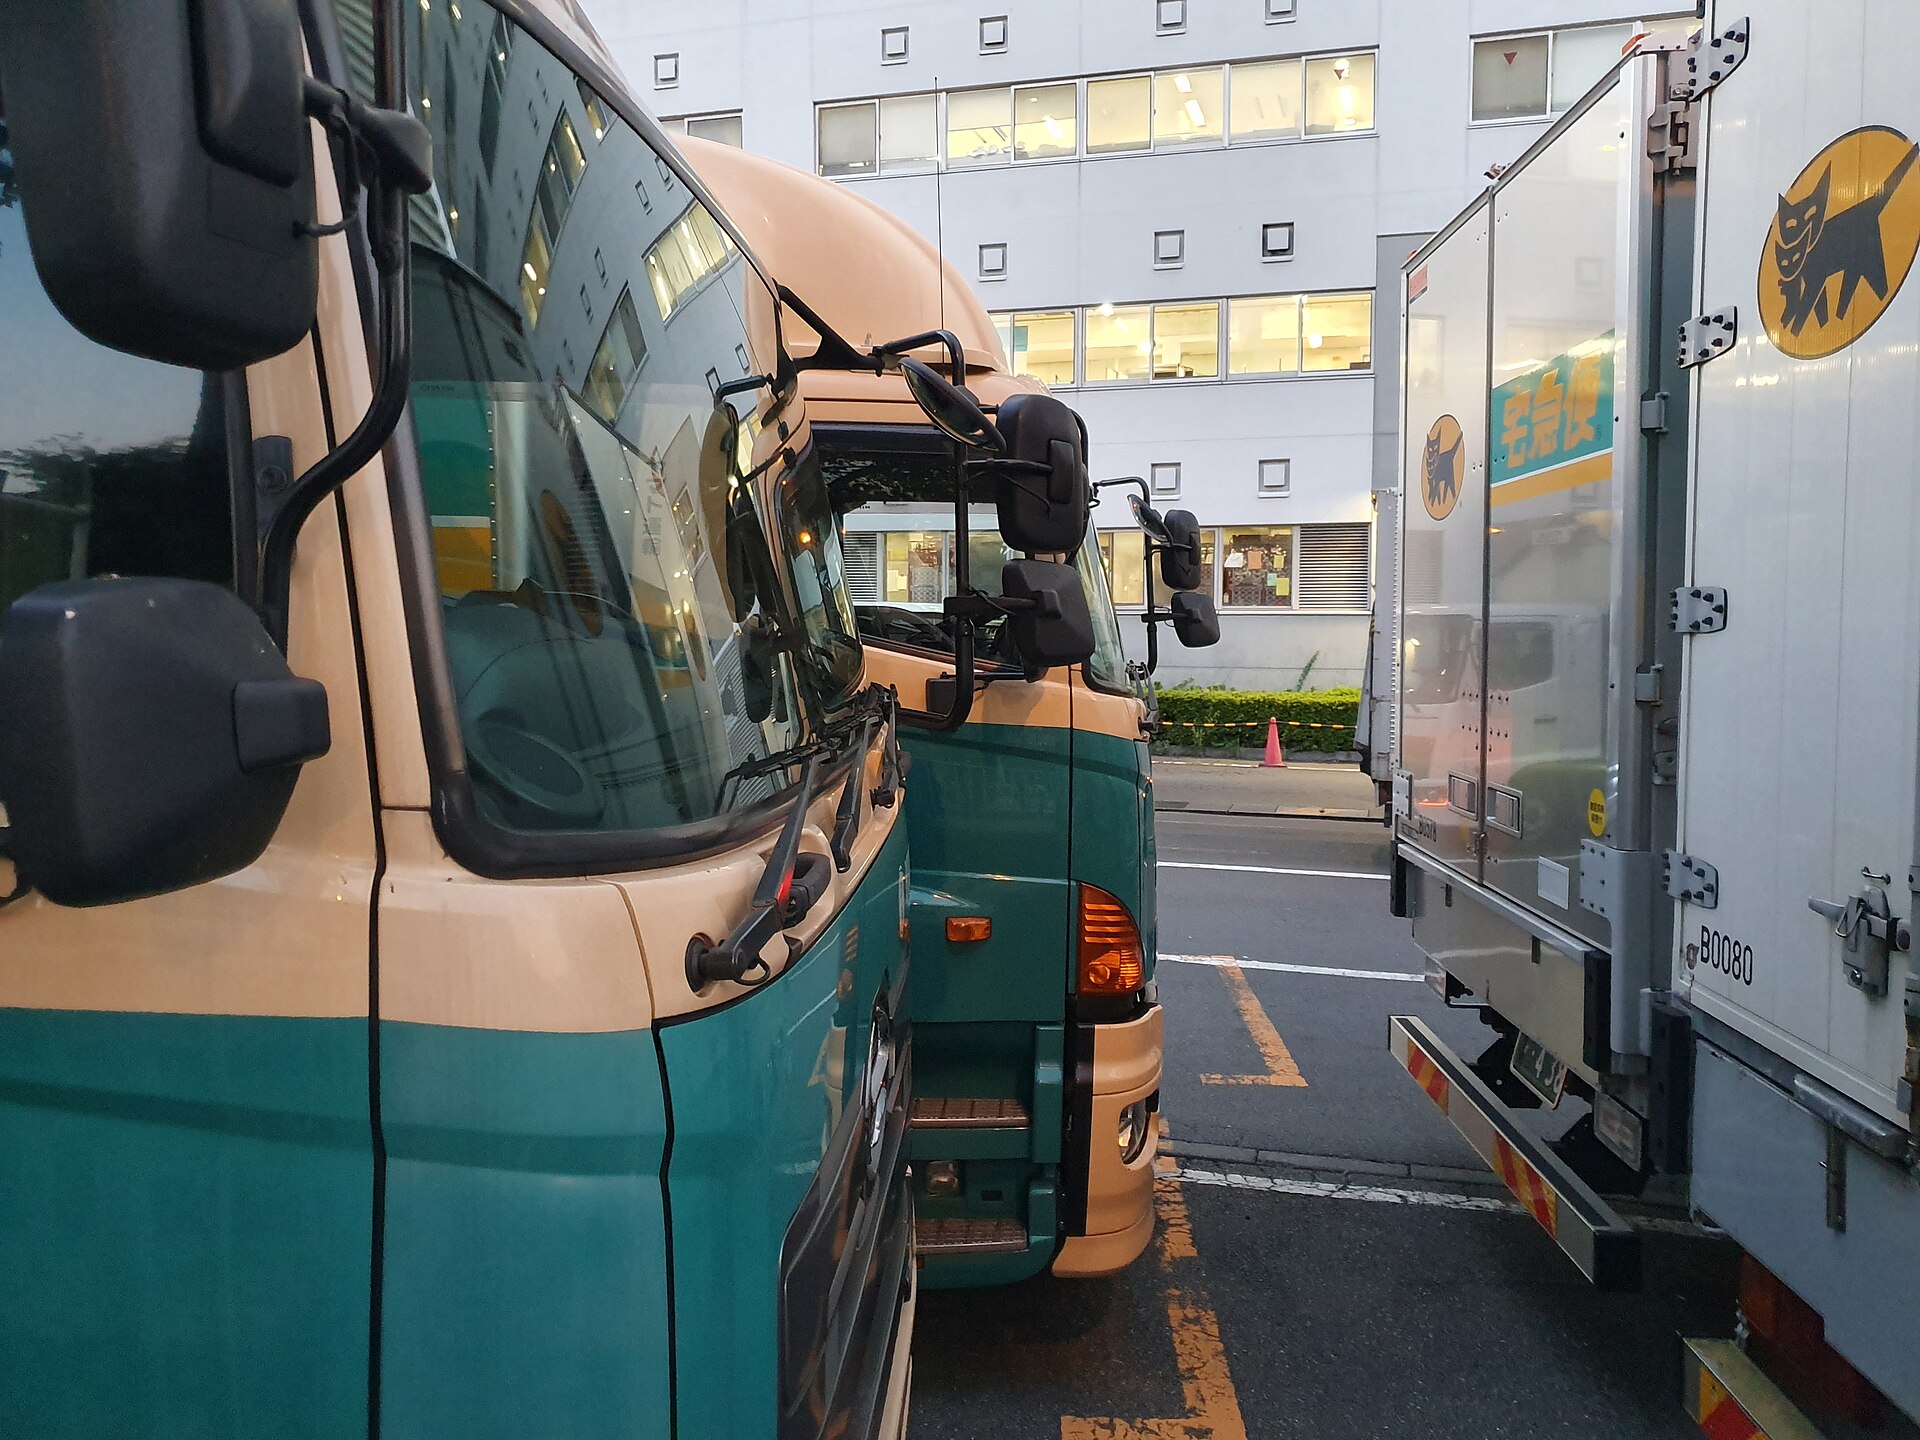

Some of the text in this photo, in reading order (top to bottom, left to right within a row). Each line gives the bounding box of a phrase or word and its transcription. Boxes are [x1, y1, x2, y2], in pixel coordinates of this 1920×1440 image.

[1501, 354, 1601, 468] 宅急便
[1701, 925, 1753, 986] B0080
